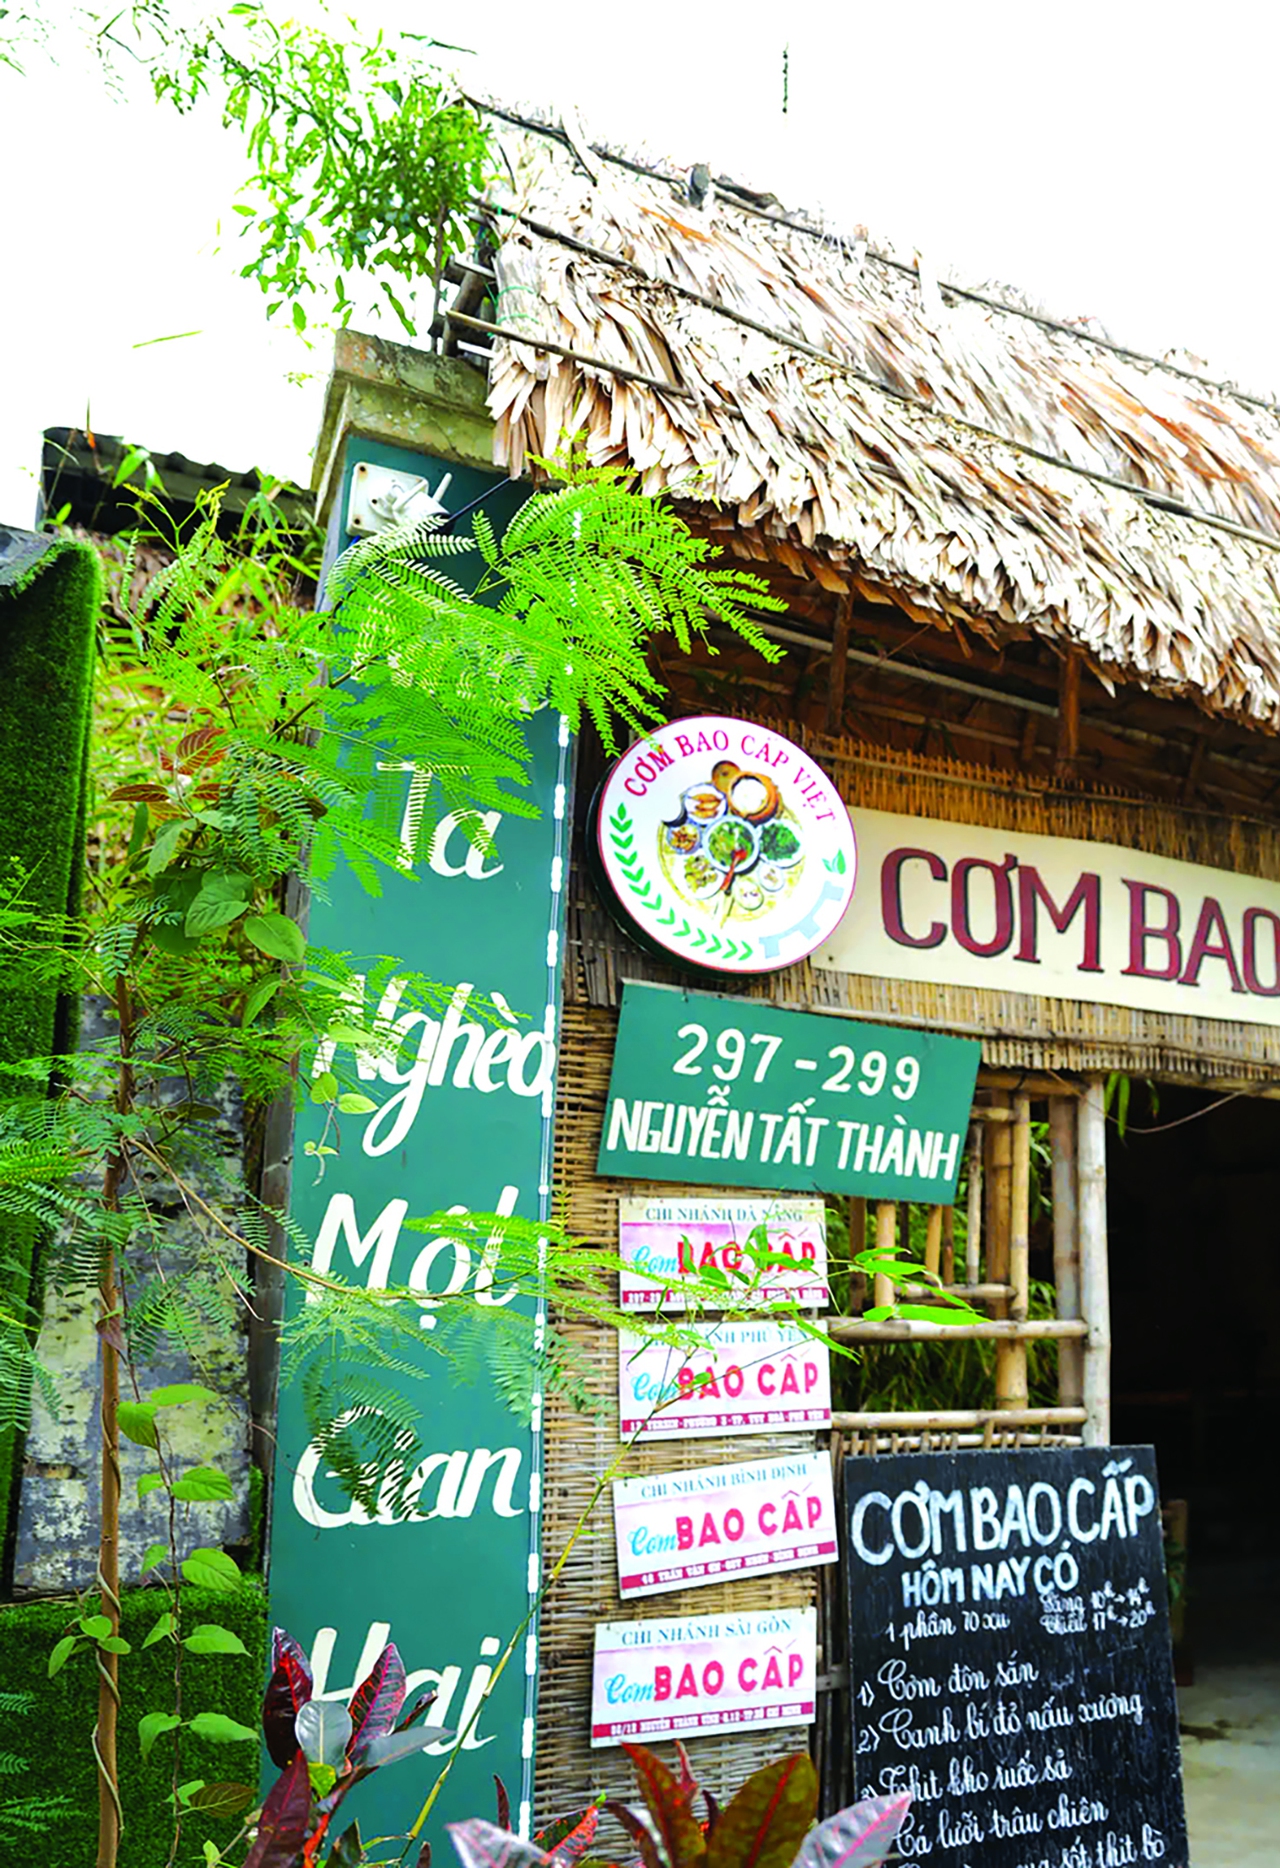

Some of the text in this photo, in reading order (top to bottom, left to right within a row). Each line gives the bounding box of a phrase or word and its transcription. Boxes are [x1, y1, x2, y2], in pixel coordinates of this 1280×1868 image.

[624, 745, 675, 797] CƠM
[675, 730, 729, 757] BAO
[793, 767, 837, 821] VIỆT
[881, 847, 1102, 974] CƠM
[673, 1023, 783, 1083] 297
[822, 1045, 921, 1101] 299
[606, 1085, 960, 1182] NGUYỄN TẤT THÀNH
[645, 1207, 672, 1221] CHI
[677, 1205, 733, 1222] NHÁNH
[757, 1348, 819, 1396] CẤP
[641, 1483, 667, 1499] CHI
[672, 1474, 727, 1495] NHÁNH
[732, 1468, 766, 1487] BÌNH
[850, 1457, 1156, 1566] CƠM BAO CẤP
[675, 1507, 745, 1551] BAO
[757, 1481, 823, 1537] CẤP
[901, 1541, 1080, 1608] HÔM NAY CÓ
[621, 1615, 793, 1646] CHI NHÁNH SÀI GÒN
[961, 1610, 980, 1632] 70
[982, 1611, 1011, 1631] xu
[653, 1660, 725, 1702] BAO
[737, 1638, 804, 1693] CẤP
[877, 1658, 942, 1702] Cơm
[948, 1662, 990, 1698] độn
[995, 1650, 1040, 1688] sắn
[855, 1725, 881, 1755] 2)
[878, 1708, 961, 1750] Canh
[966, 1701, 991, 1740] bí
[993, 1701, 1022, 1737] đỏ
[1027, 1694, 1075, 1732] nấu
[947, 1755, 989, 1797] kho
[992, 1749, 1039, 1790] ruốc
[1041, 1748, 1073, 1783] sả
[936, 1809, 985, 1849] lưỡi
[988, 1806, 1043, 1839] trâu
[1047, 1793, 1110, 1831] chiên
[1141, 1823, 1166, 1861] bò
